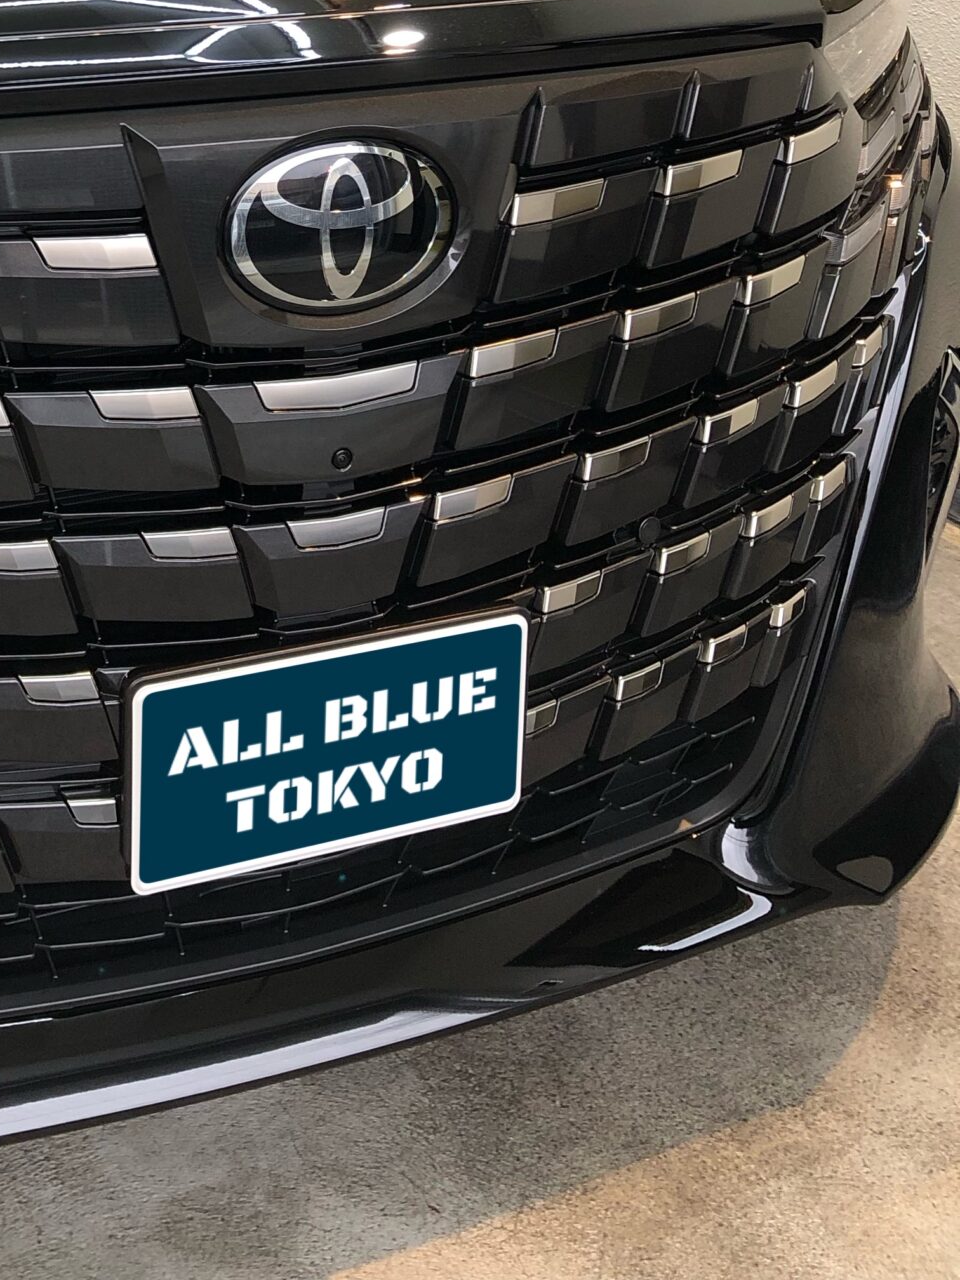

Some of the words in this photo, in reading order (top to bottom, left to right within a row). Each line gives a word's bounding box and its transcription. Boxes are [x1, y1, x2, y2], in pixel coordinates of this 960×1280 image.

[167, 710, 304, 777] ALL
[324, 667, 497, 744] BLUE
[225, 747, 444, 833] TOKYO
